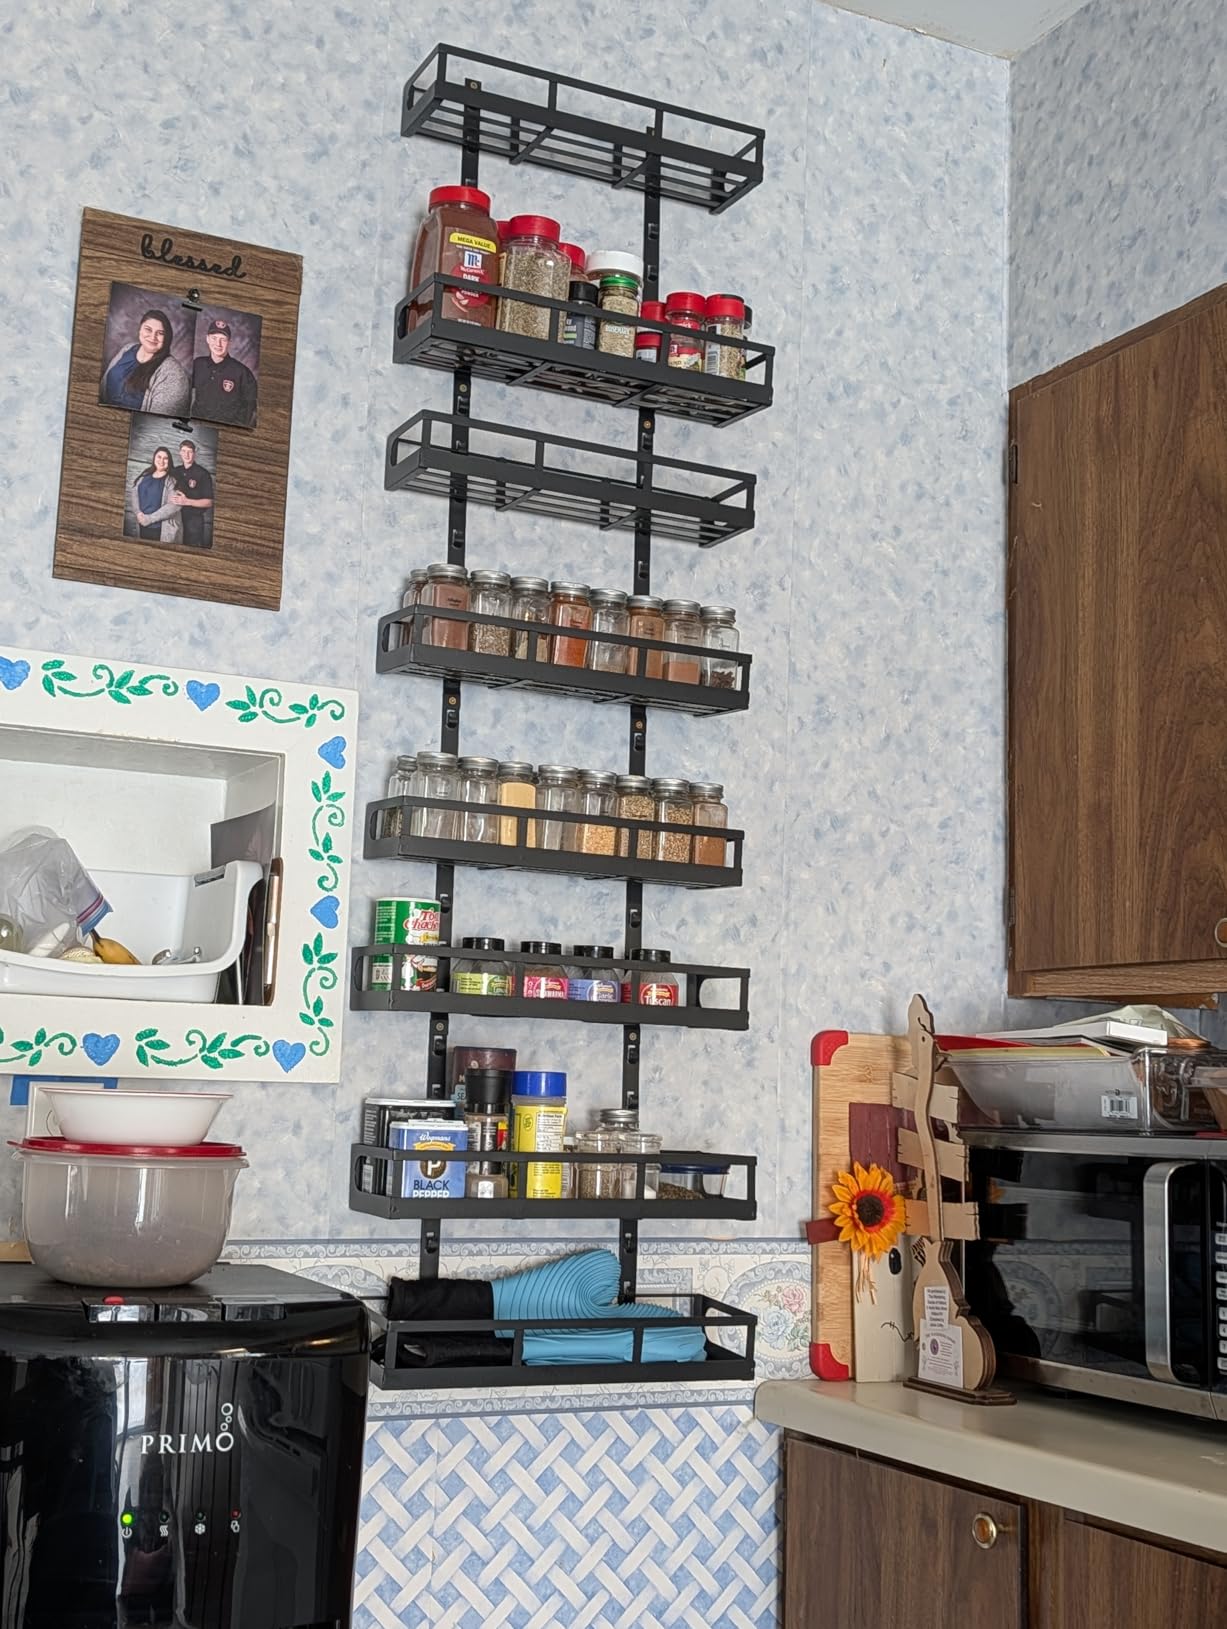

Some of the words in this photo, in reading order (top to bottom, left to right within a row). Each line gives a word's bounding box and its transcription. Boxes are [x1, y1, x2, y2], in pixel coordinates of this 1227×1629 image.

[457, 236, 474, 245] MEGA
[475, 239, 491, 249] VALUE
[141, 233, 247, 279] blessed
[462, 273, 480, 283] DARK
[644, 995, 672, 1007] Tuscan
[418, 1131, 451, 1143] Wegmans
[413, 1179, 450, 1191] BLACK
[140, 1432, 235, 1454] PRIMO
